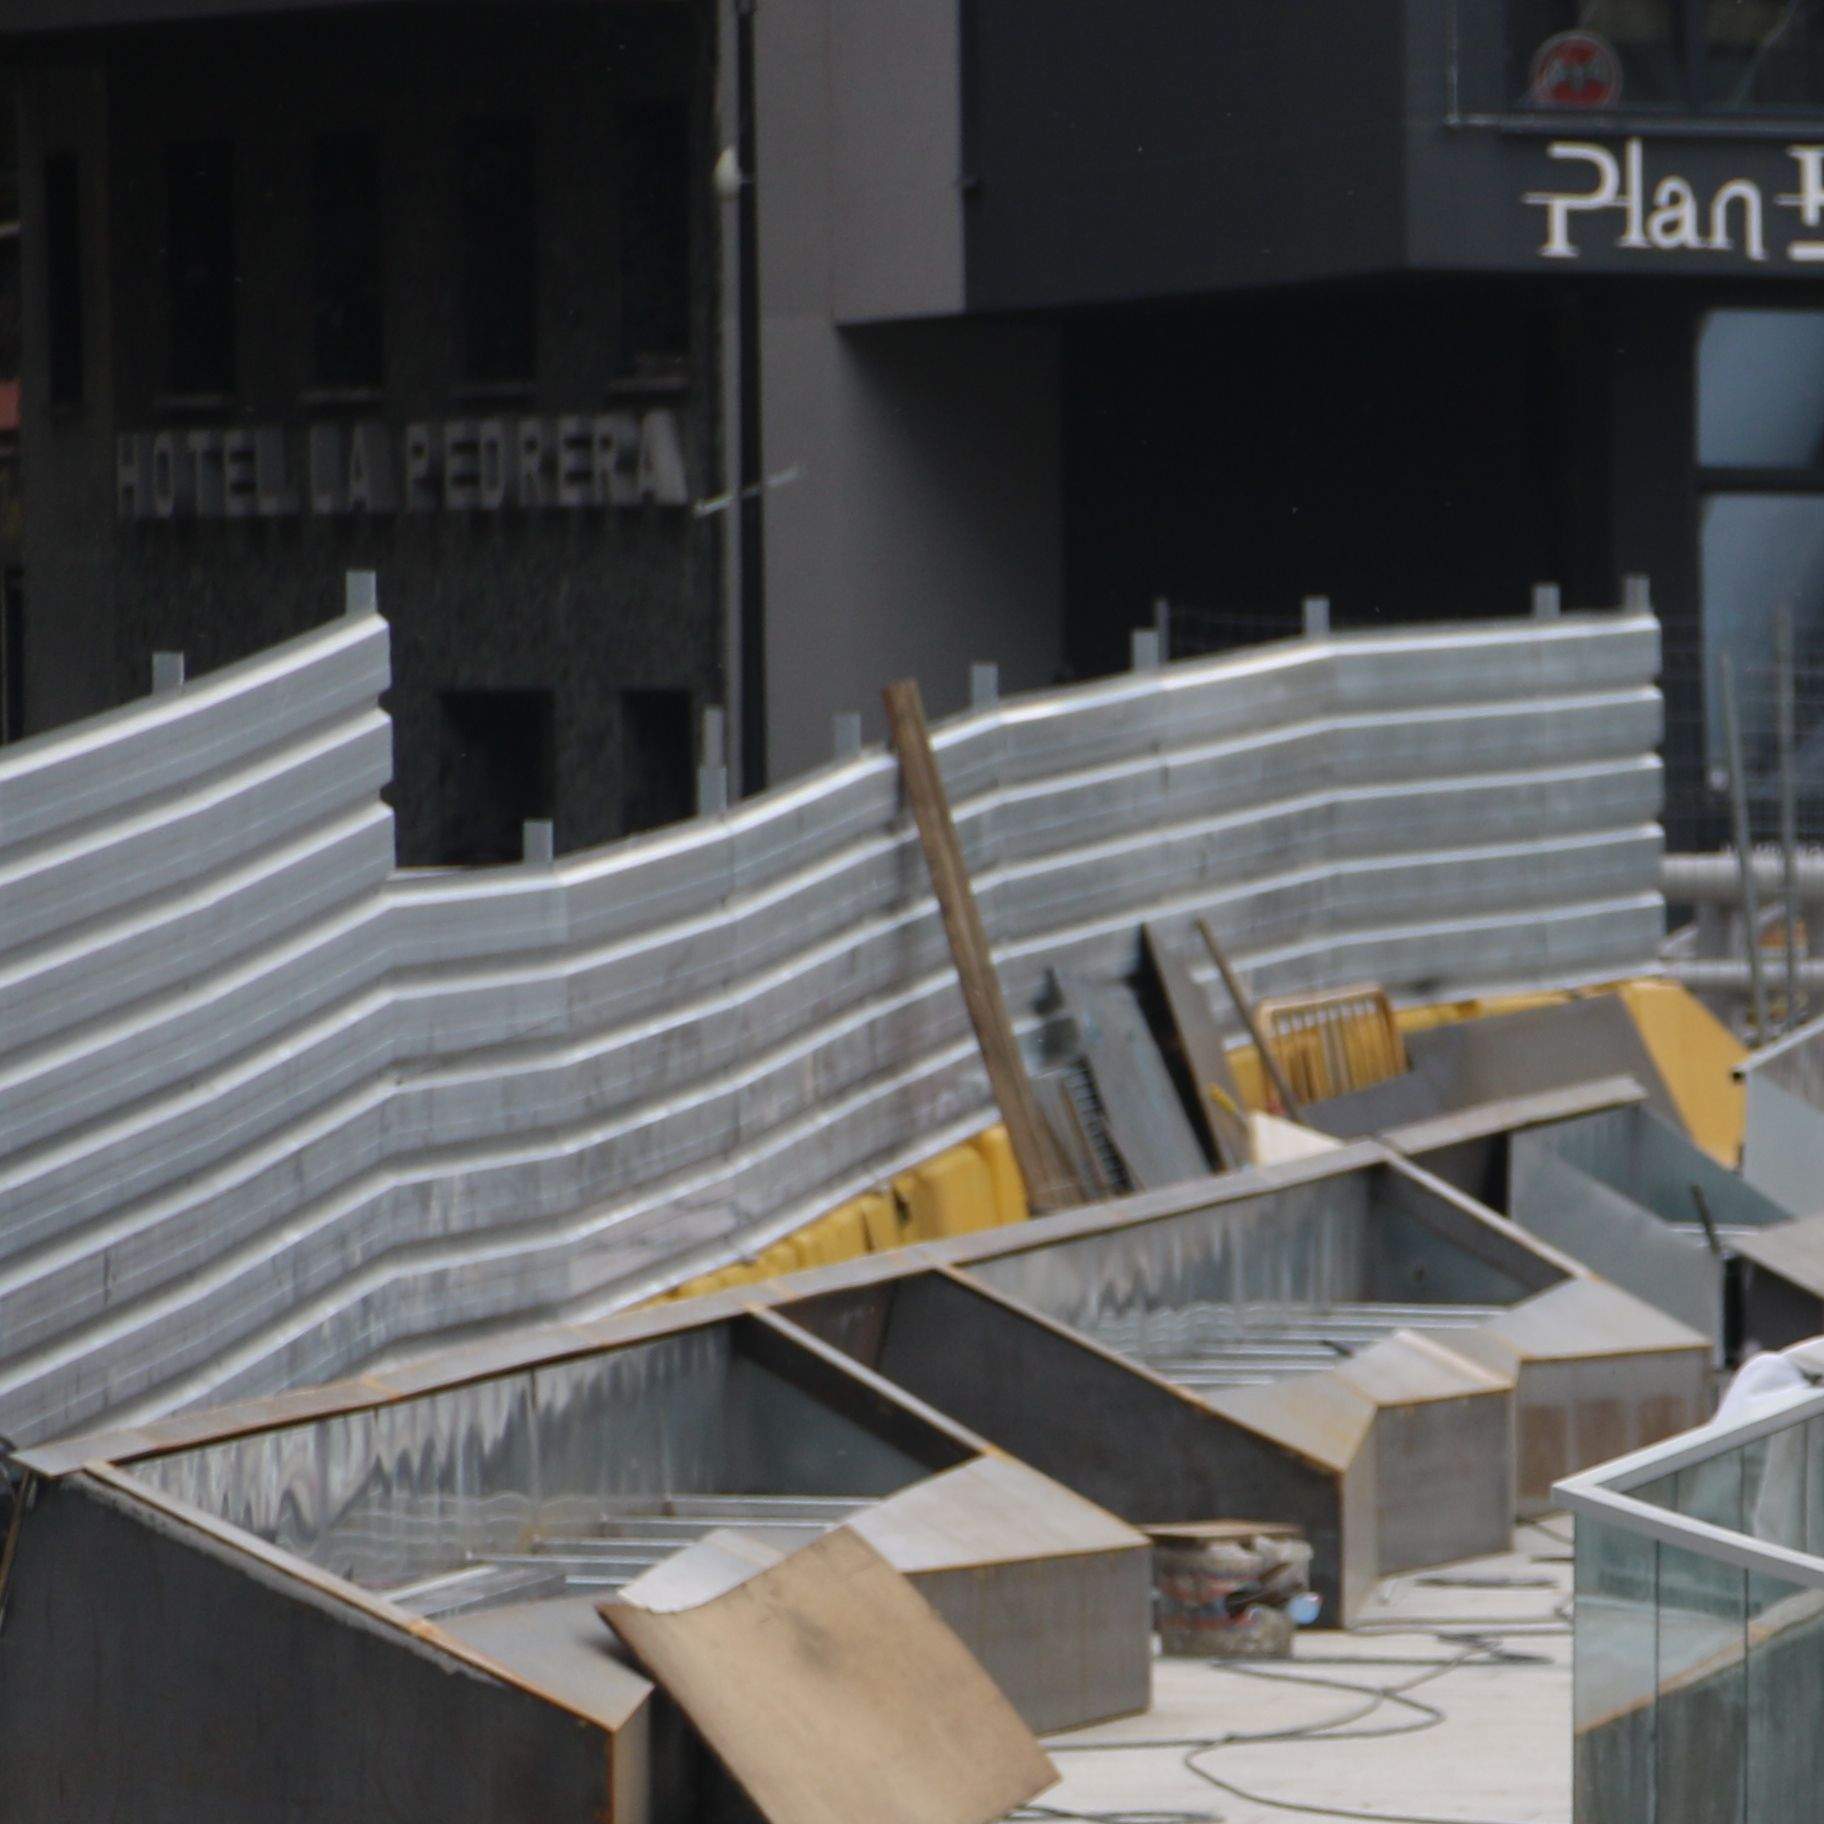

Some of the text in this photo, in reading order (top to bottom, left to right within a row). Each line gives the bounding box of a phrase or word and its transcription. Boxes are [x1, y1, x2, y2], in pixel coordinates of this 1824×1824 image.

[1524, 137, 1766, 262] Plan
[116, 407, 689, 519] HOTEL LA PEDRERA
